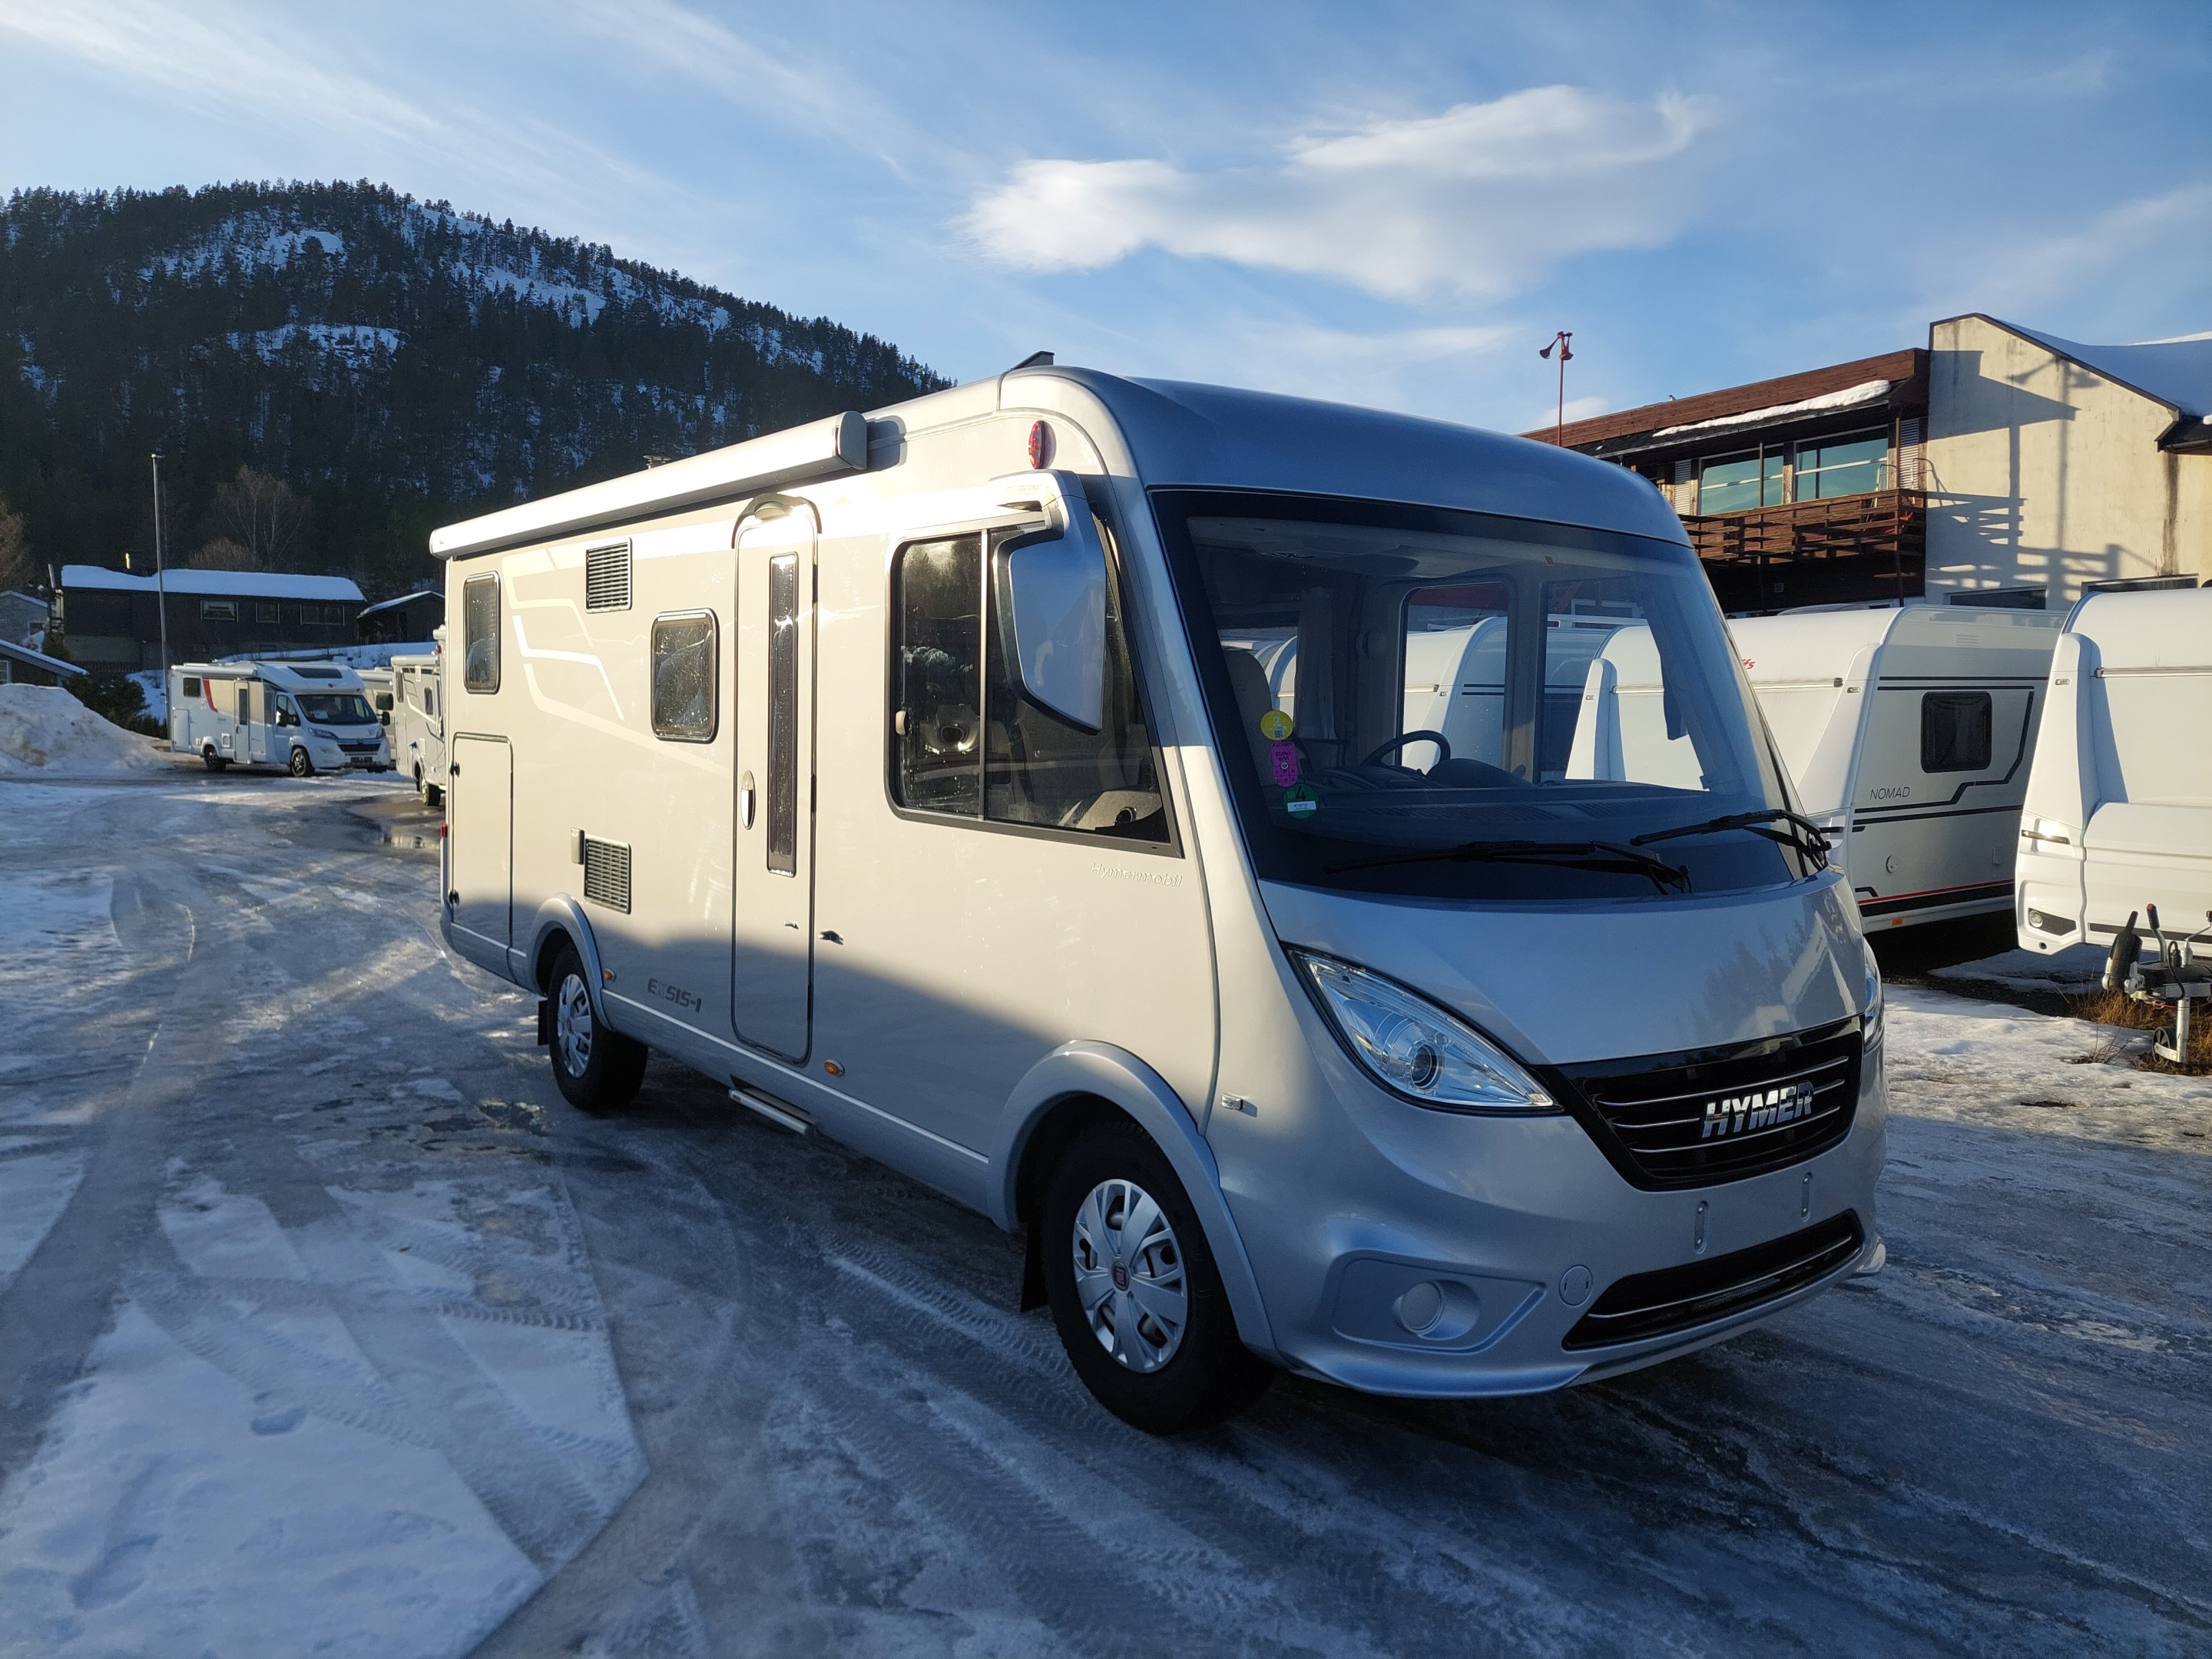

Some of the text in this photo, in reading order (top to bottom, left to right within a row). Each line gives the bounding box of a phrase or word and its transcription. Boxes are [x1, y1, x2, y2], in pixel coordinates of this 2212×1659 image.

[1296, 784, 1306, 801] 4
[1869, 786, 1911, 800] NOMAD
[1090, 862, 1183, 888] Hymermobil
[1701, 1080, 1814, 1138] HYMER
